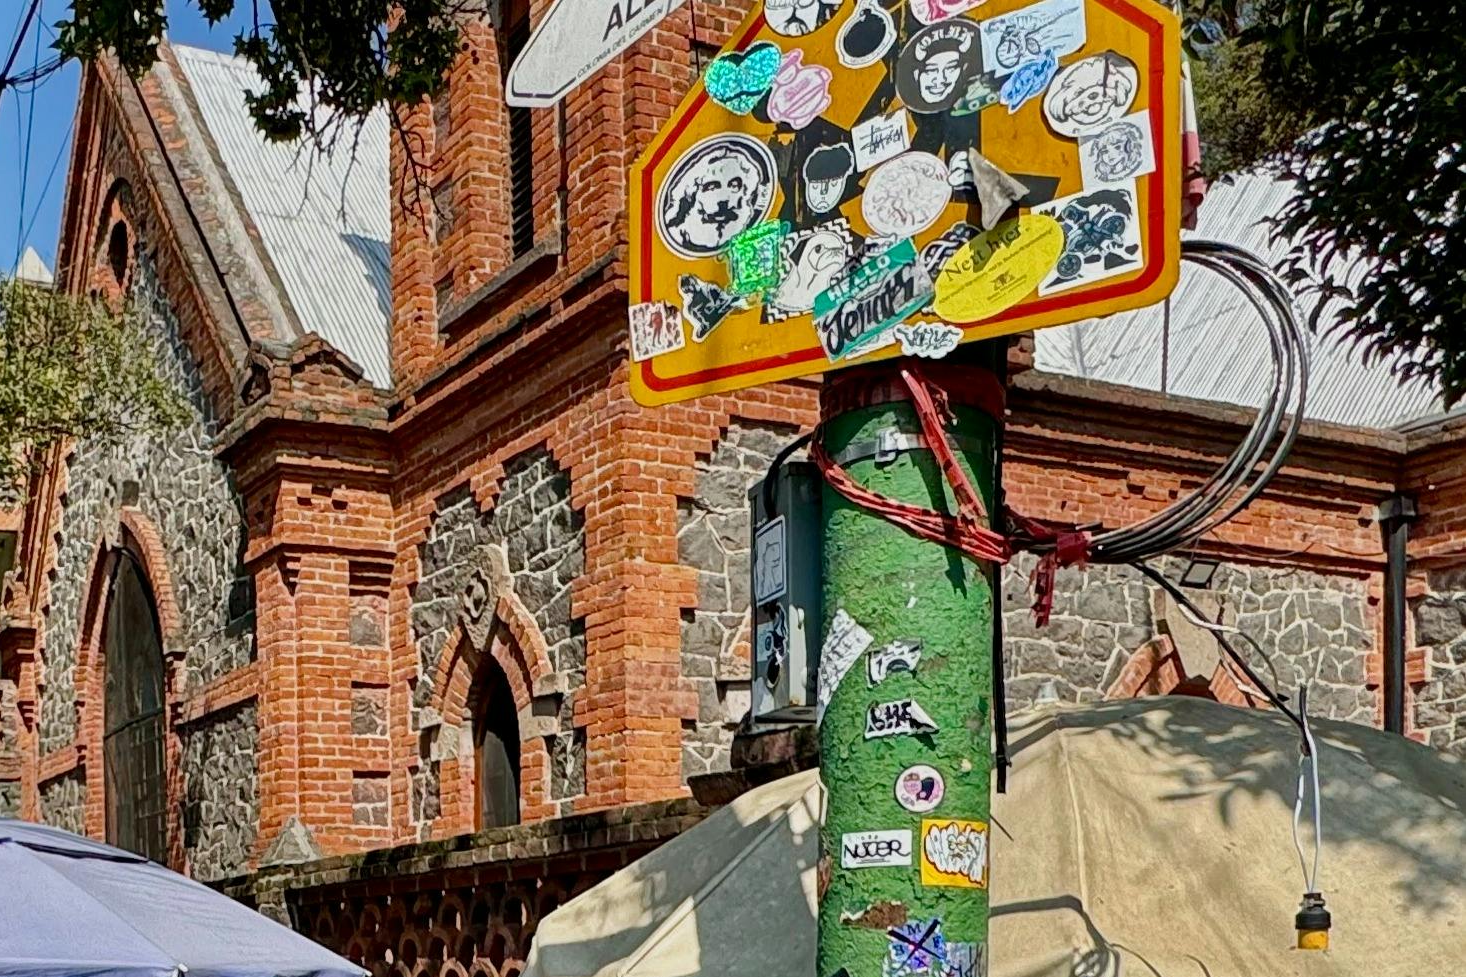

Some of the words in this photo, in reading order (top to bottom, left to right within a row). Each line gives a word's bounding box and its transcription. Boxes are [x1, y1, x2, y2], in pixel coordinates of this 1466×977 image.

[577, 48, 611, 77] COLONIA
[609, 36, 626, 53] DEL
[630, 4, 664, 38] CARMEN
[602, 0, 656, 42] AL
